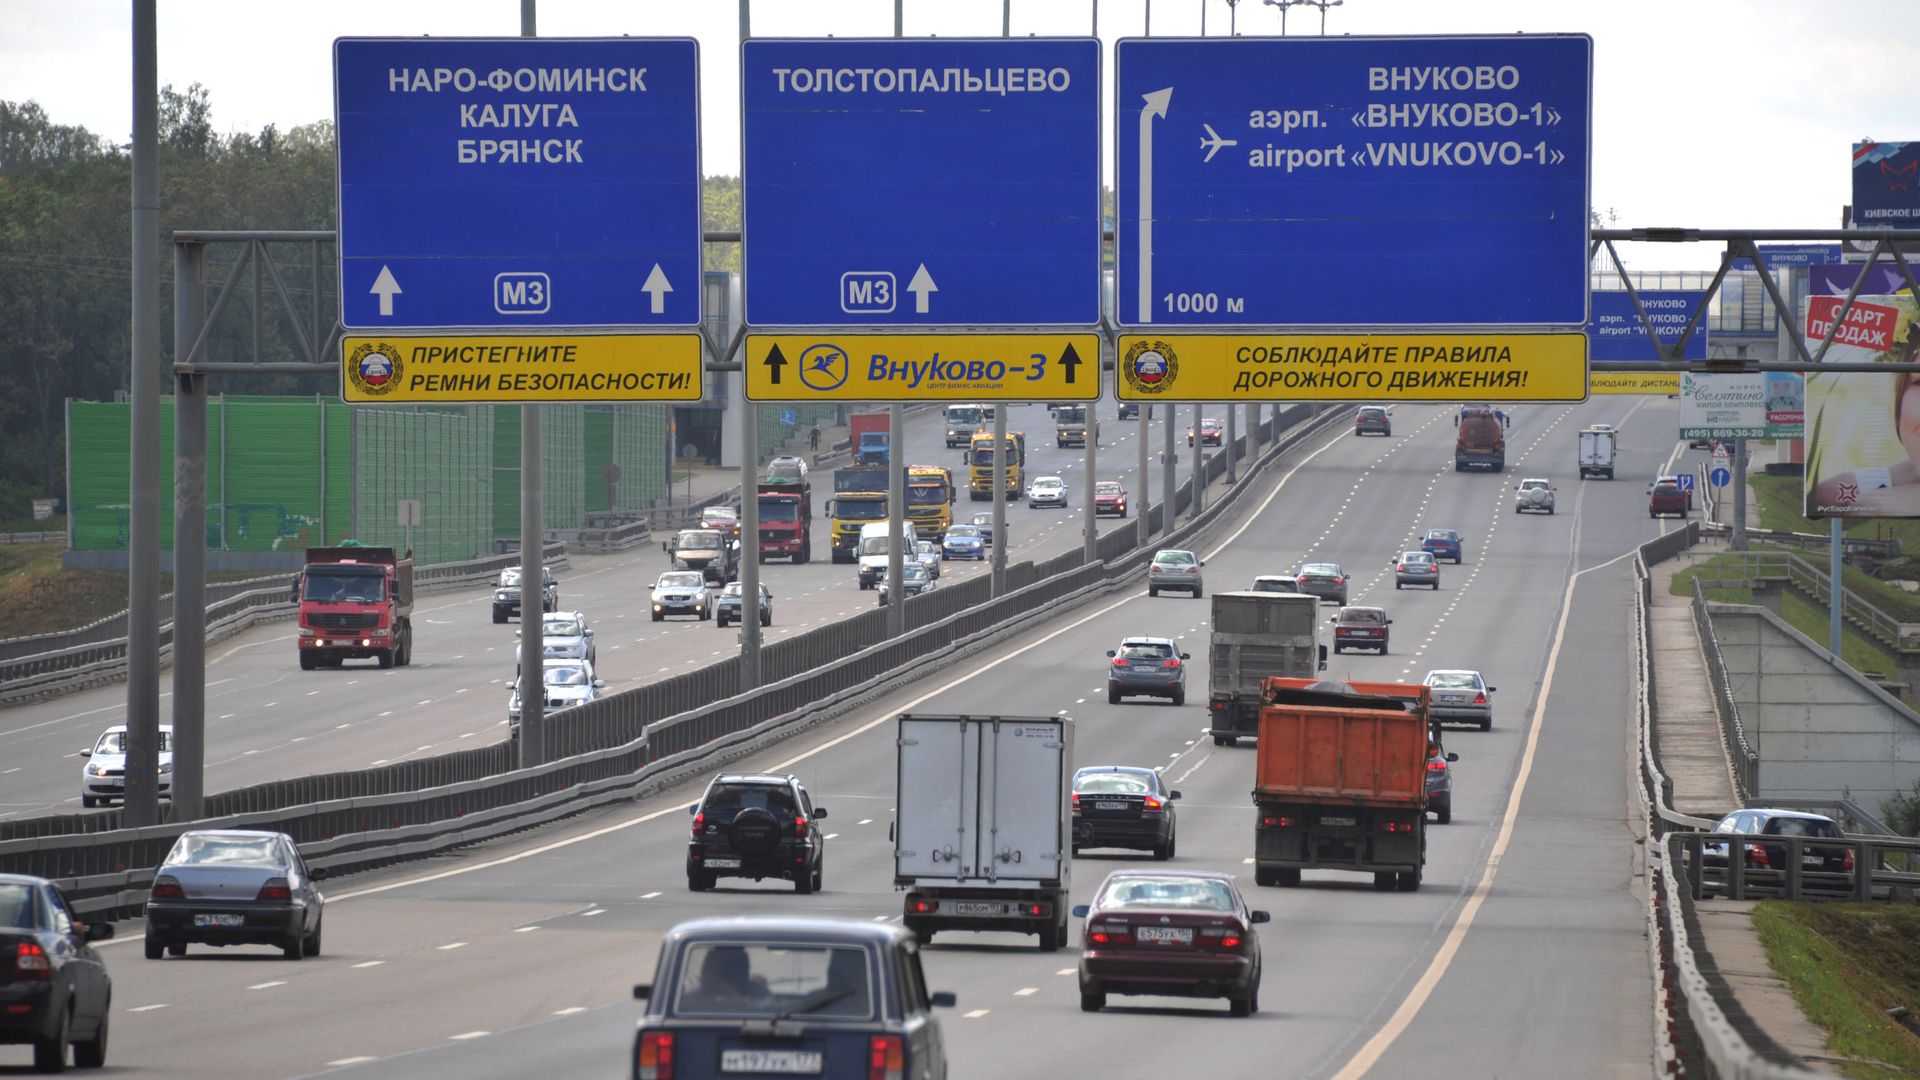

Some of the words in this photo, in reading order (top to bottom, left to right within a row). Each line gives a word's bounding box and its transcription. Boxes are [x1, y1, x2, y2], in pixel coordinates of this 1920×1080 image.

[389, 67, 647, 92] НАРО-ФОМИНСК
[772, 67, 1071, 96] ТОЛСТОПАЛЬЦЕВО
[1368, 65, 1520, 91] ВНУКОВО
[460, 104, 579, 128] КАЛУГА
[1249, 109, 1327, 134] аэрп.
[1351, 103, 1562, 129] «ВНУКОВО-1»
[457, 139, 584, 164] БРЯНСК
[1248, 144, 1345, 173] airport
[1351, 141, 1565, 167] «VNUKOVO-1»
[1864, 208, 1910, 219] КИЕВСКОЕ
[502, 281, 544, 305] M3
[849, 280, 890, 304] M3
[1163, 292, 1219, 313] 1000
[1226, 297, 1244, 313] м
[1599, 326, 1631, 336] airport
[411, 345, 578, 364] ПРИСТЕГНИТЕ
[1236, 343, 1399, 367] СОБЛЮДАЙТЕ
[1404, 346, 1513, 364] ПРАВИЛА
[410, 374, 491, 392] РЕМНИ
[497, 373, 691, 391] БЕЗОПАСНОСТИ!
[1233, 370, 1383, 393] ДОРОЖНОГО
[1386, 370, 1529, 392] ДВИЖЕНИЯ!
[1591, 379, 1637, 388] БЛЮДАЙТЕ
[1640, 379, 1680, 388] ДИСТАНЦ
[1684, 428, 1711, 439] (495)
[1713, 428, 1764, 438] 669-30-20
